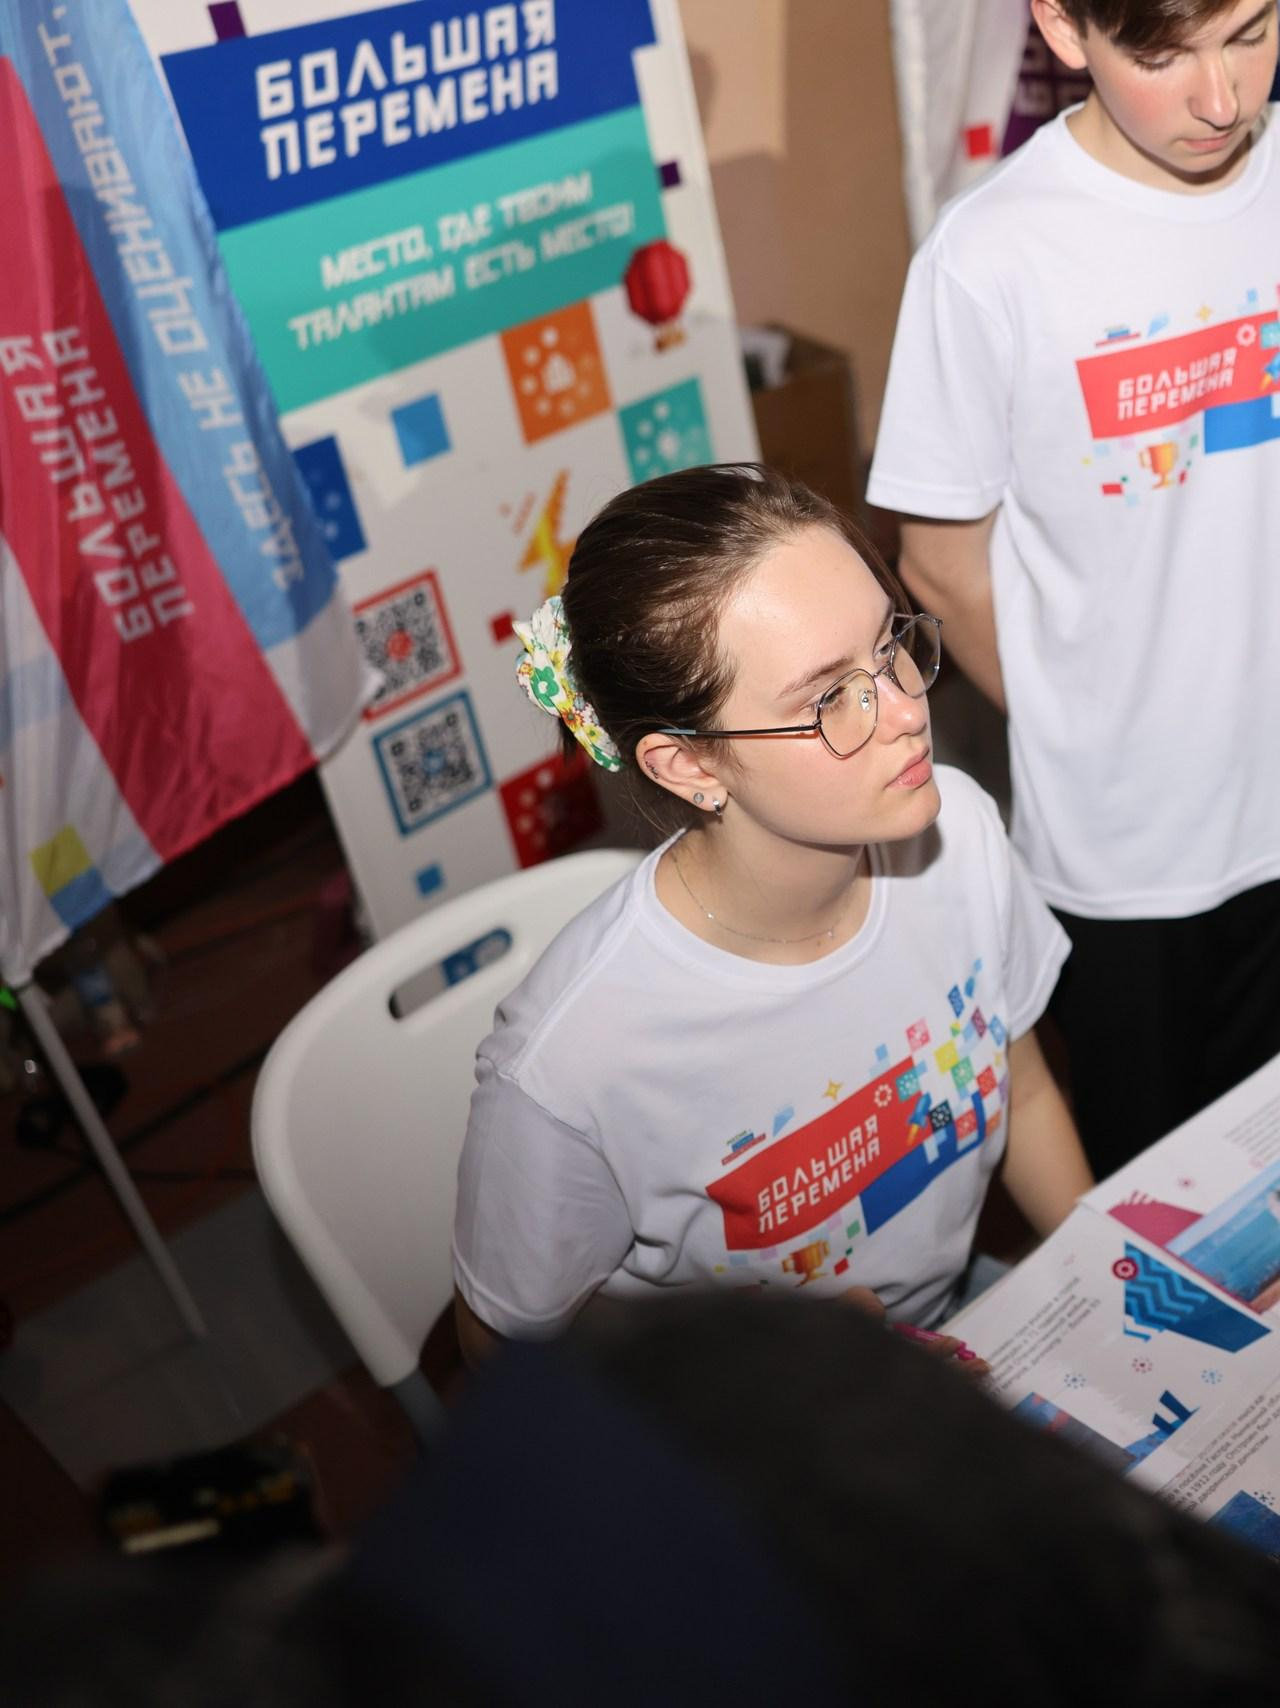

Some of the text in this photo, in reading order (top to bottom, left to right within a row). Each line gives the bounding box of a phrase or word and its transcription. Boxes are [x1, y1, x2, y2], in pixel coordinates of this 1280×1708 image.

[256, 0, 555, 120] БОЛЬШАЯ
[261, 49, 558, 180] ПЕРЕМЕНА
[437, 203, 492, 251] ГДЕ
[497, 170, 592, 227] ТВОИМ
[288, 263, 455, 350] ТАЛАНТАМ
[464, 239, 537, 289] ЕСТЬ
[177, 367, 244, 431] НЕ
[1118, 347, 1237, 400] БОЛЬШАЯ
[1118, 368, 1234, 421] ПЕРЕМЕНА
[0, 335, 153, 642] БОЛЬШАЯ
[42, 327, 195, 627] ПЕРЕМЕНА
[758, 1114, 878, 1212] БОЛЬШАЯ
[758, 1137, 880, 1234] ПЕРЕМЕНА
